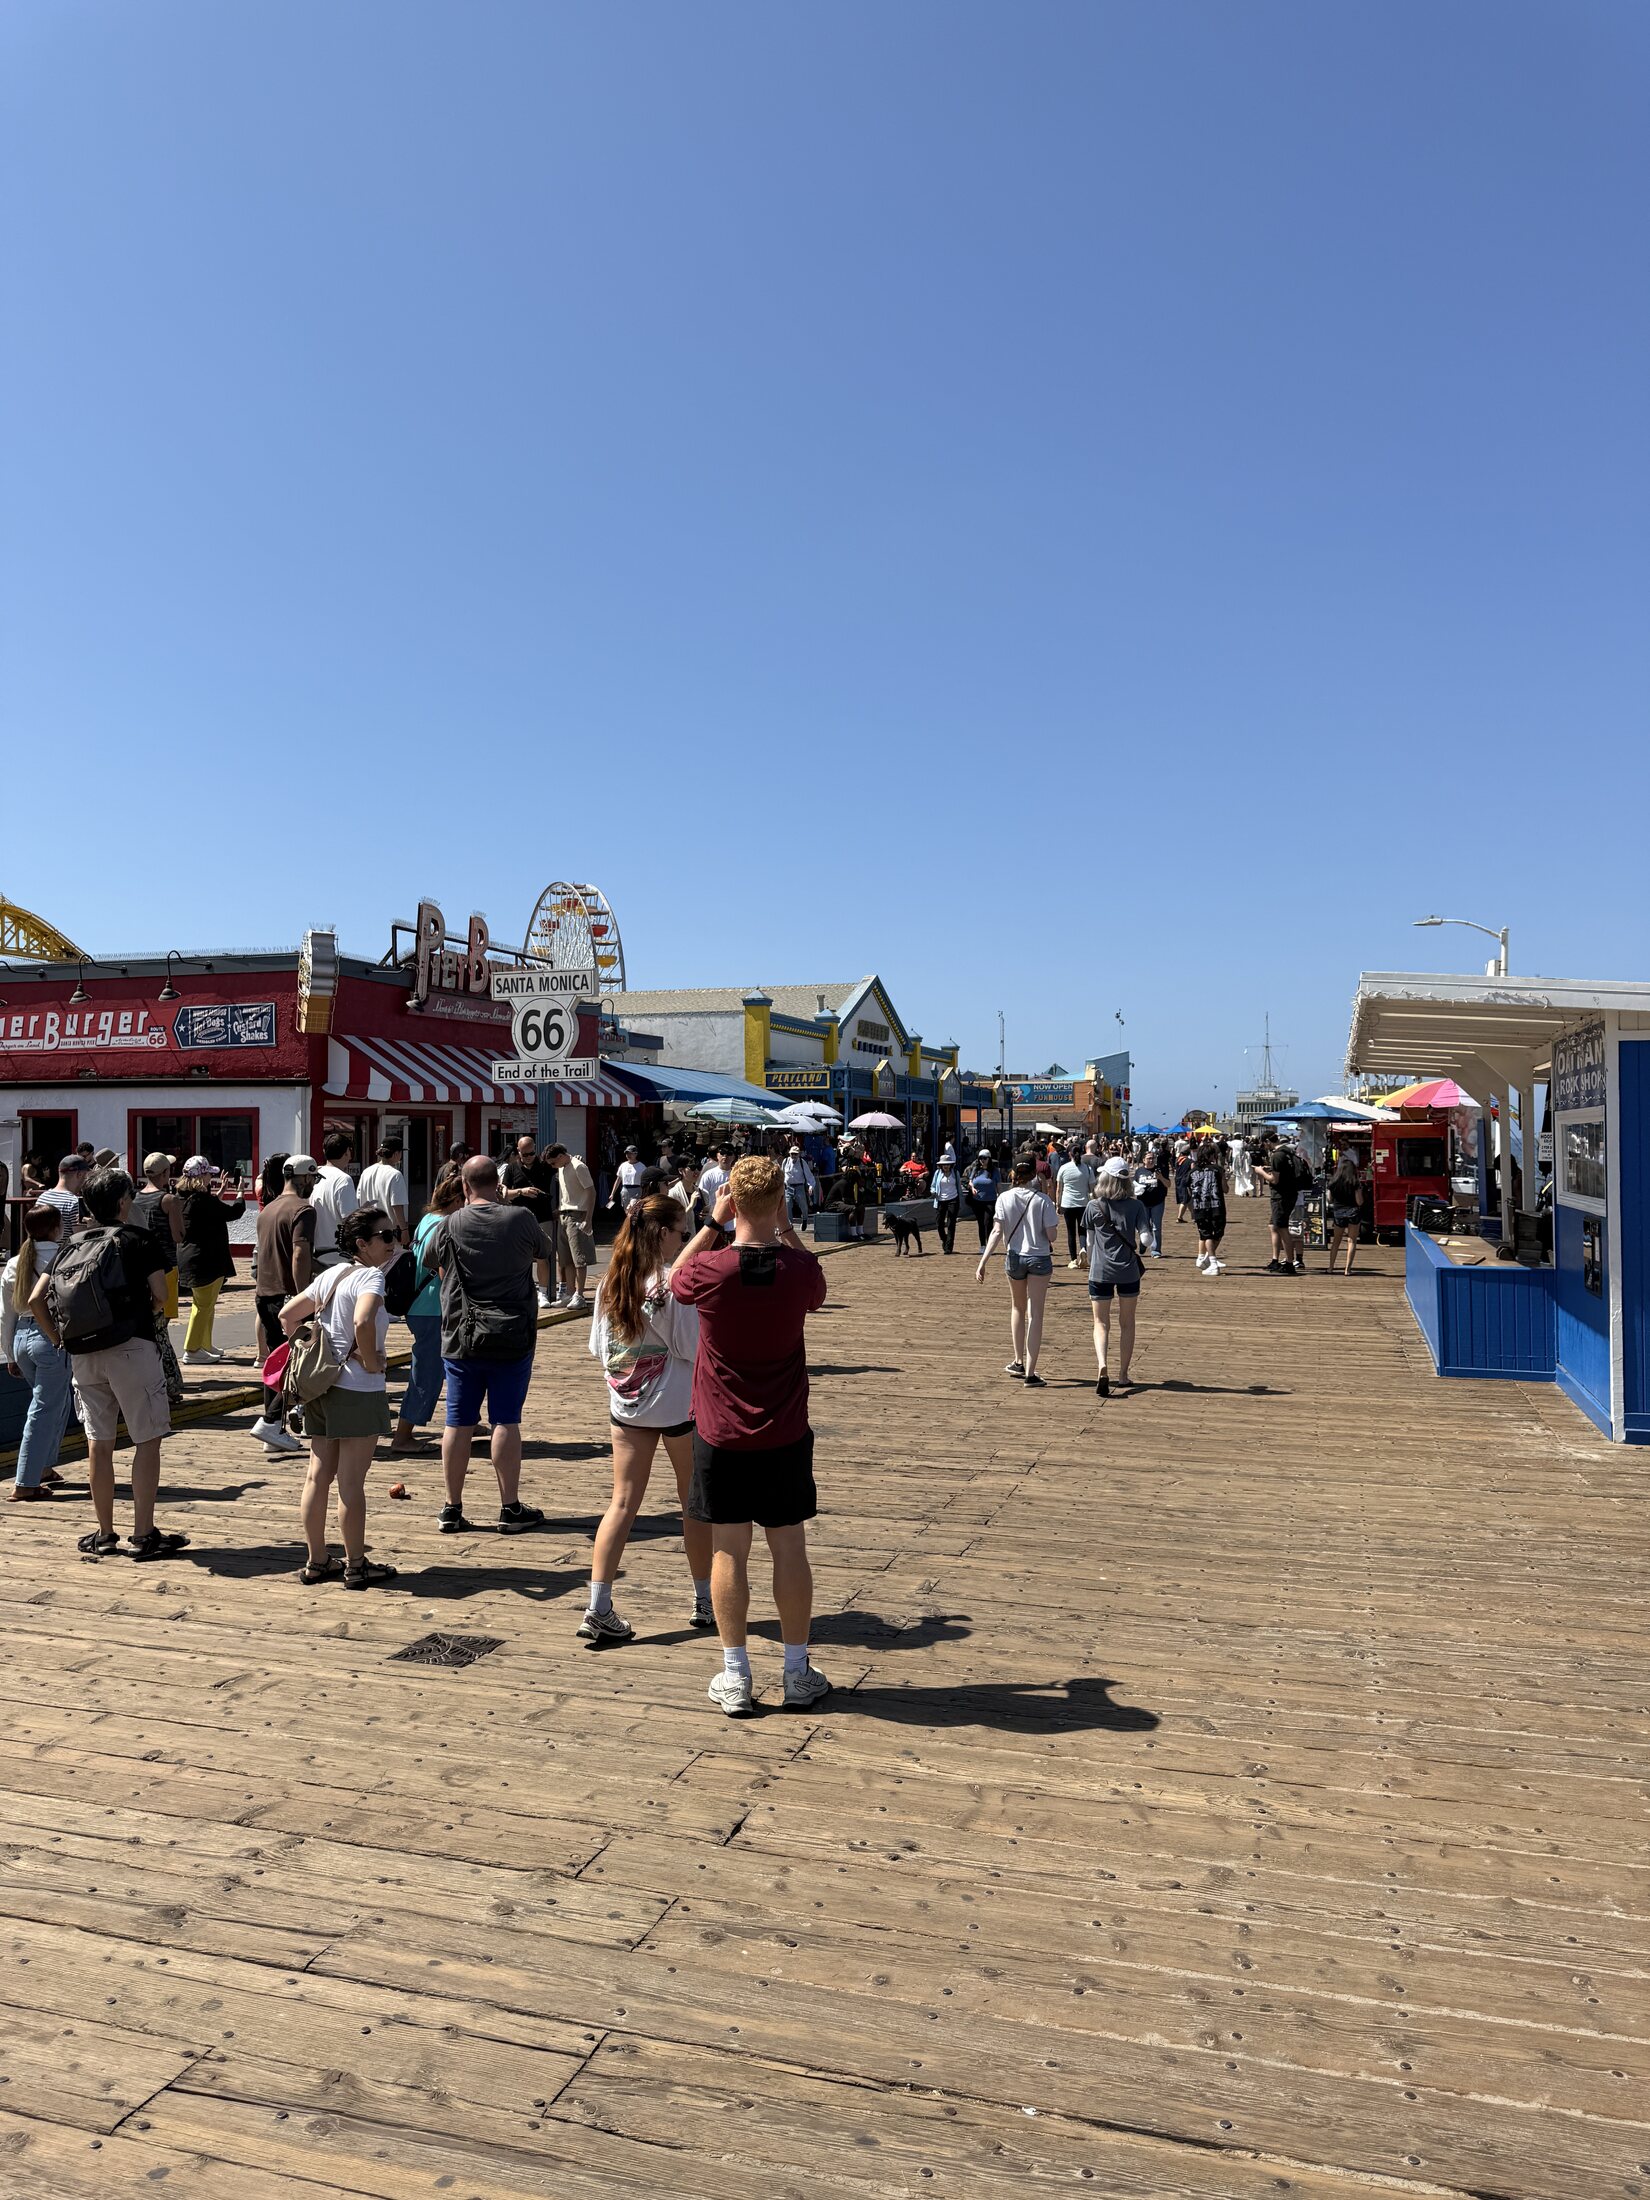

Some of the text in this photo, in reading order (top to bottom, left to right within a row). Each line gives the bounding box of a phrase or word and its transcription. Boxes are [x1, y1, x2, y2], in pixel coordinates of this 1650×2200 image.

[495, 974, 590, 994] SANTA MONICA
[193, 1016, 225, 1038] Hot Dogs
[233, 1016, 262, 1035] Custard
[521, 1008, 565, 1052] 66
[149, 1034, 165, 1046] 66
[240, 1031, 269, 1043] Shakes
[498, 1062, 590, 1079] End of the Trail
[771, 1074, 823, 1083] PLAYLAND
[1580, 1070, 1602, 1091] SHOP
